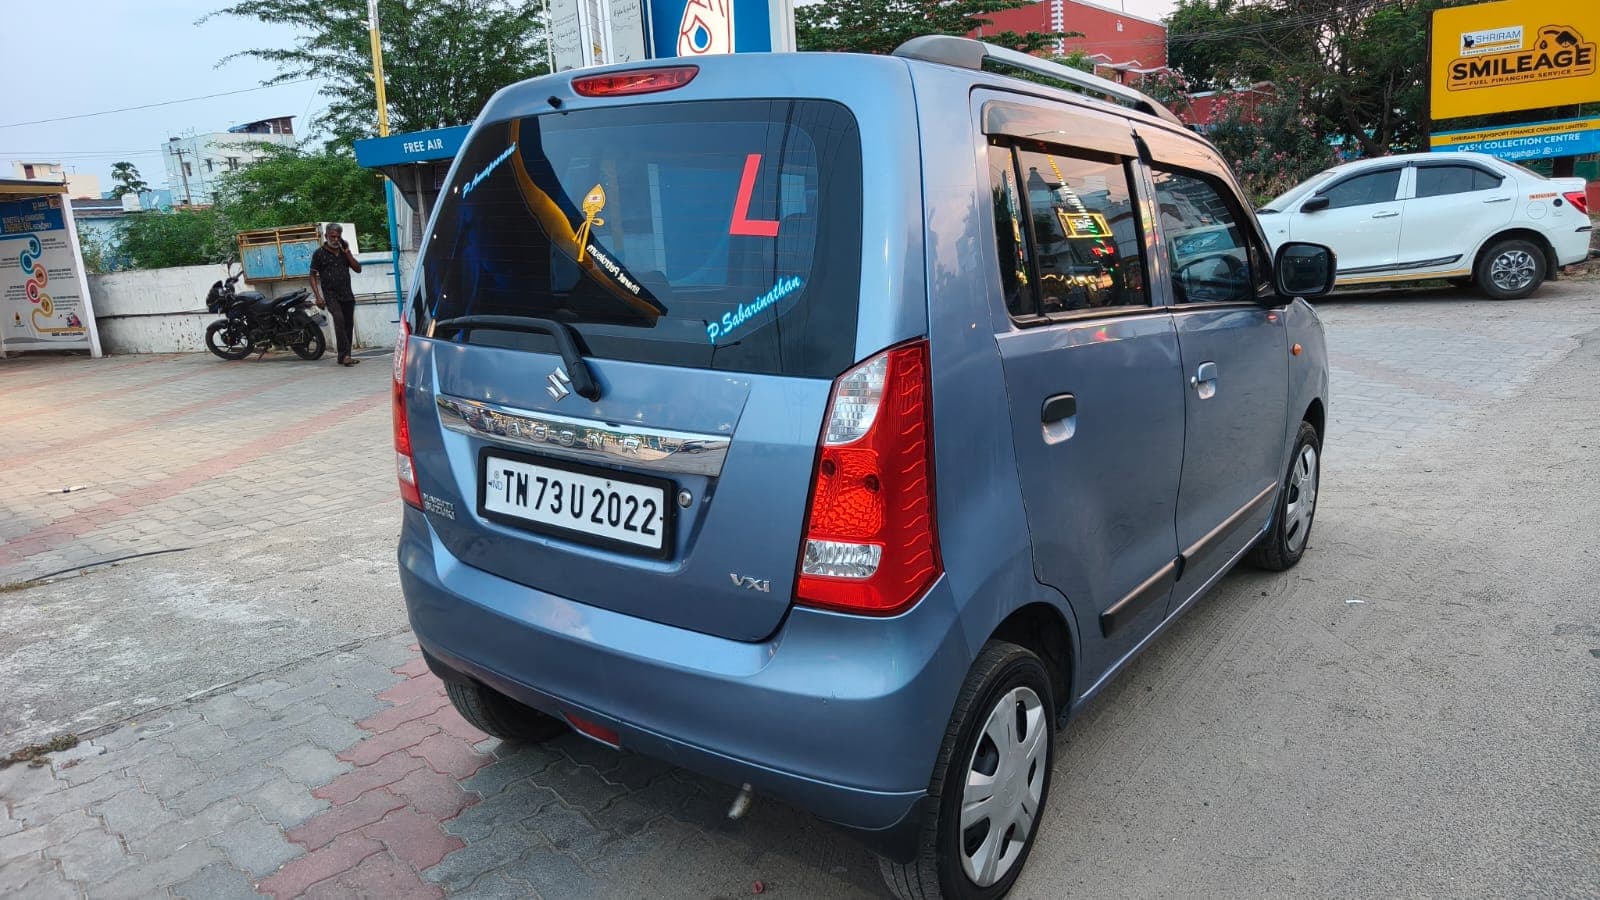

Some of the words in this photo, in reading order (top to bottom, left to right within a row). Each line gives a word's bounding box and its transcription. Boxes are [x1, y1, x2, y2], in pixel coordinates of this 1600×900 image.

[1475, 30, 1521, 43] SHRIRAM
[1452, 47, 1592, 80] SMILEAGE
[1469, 78, 1488, 86] FUEL
[1491, 73, 1535, 84] FINANCING
[1538, 69, 1572, 79] SERVICE
[1450, 134, 1476, 142] SHRIRAM
[1477, 131, 1510, 140] TRANSPORT
[1510, 128, 1535, 136] FINANCE
[1536, 125, 1565, 133] COMPANY
[1565, 122, 1589, 130] LIMITED
[403, 140, 425, 153] FREE
[427, 138, 444, 151] AIR
[1457, 144, 1482, 152] CASH
[1484, 138, 1542, 150] COLLECTION
[1544, 133, 1580, 144] CENTRE
[729, 154, 780, 236] L
[706, 275, 802, 344] P.Sabarinathan
[503, 469, 528, 507] TN
[535, 476, 563, 514] 73
[570, 483, 585, 519] U
[591, 488, 657, 536] 2022
